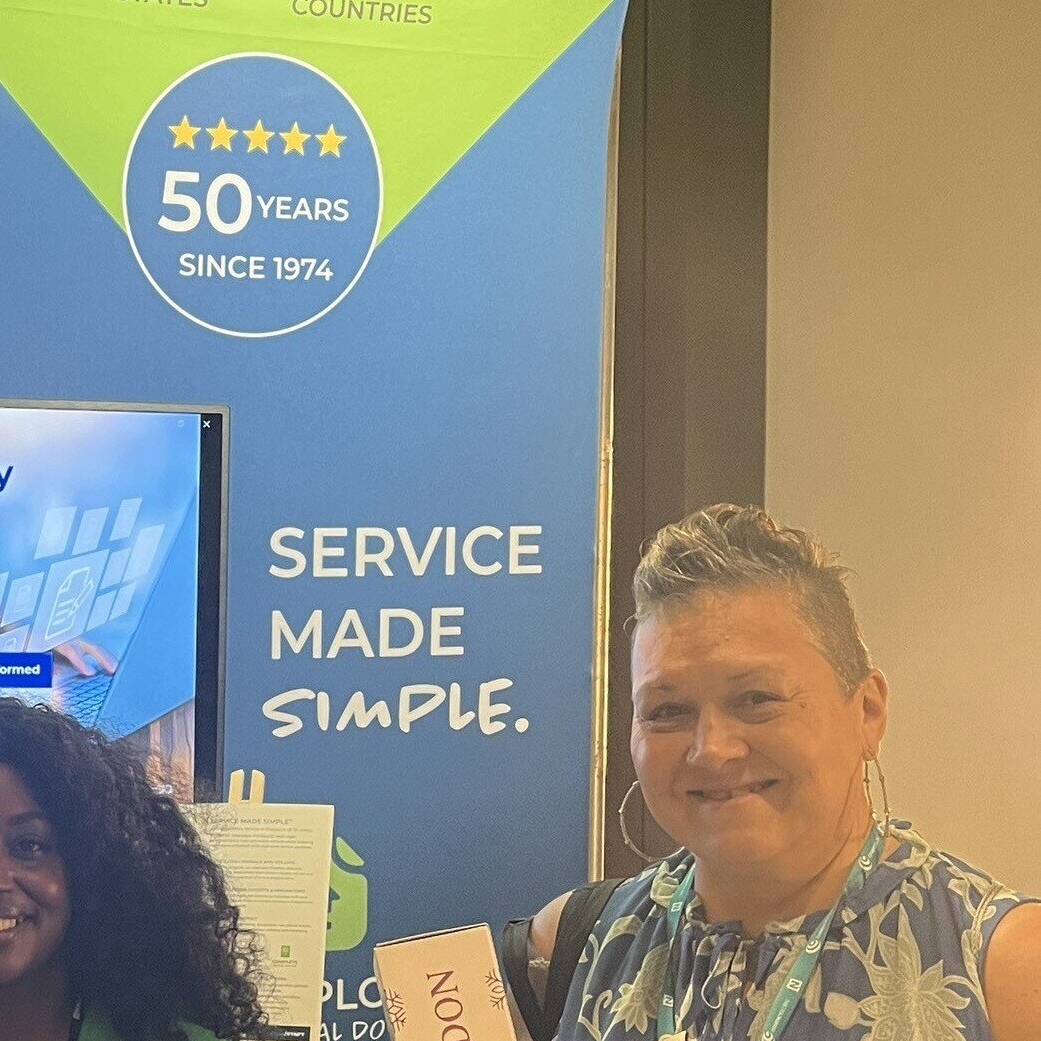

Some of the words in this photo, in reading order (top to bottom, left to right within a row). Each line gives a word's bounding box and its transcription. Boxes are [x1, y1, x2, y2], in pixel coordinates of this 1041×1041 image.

[292, 0, 433, 25] COUNTRIES
[157, 169, 252, 235] 50
[256, 196, 349, 223] YEARS
[178, 253, 265, 280] SINCE
[272, 257, 334, 281] 1974
[269, 525, 543, 579] SERVICE
[270, 606, 465, 660] MADE
[262, 677, 530, 739] SIMPLE.
